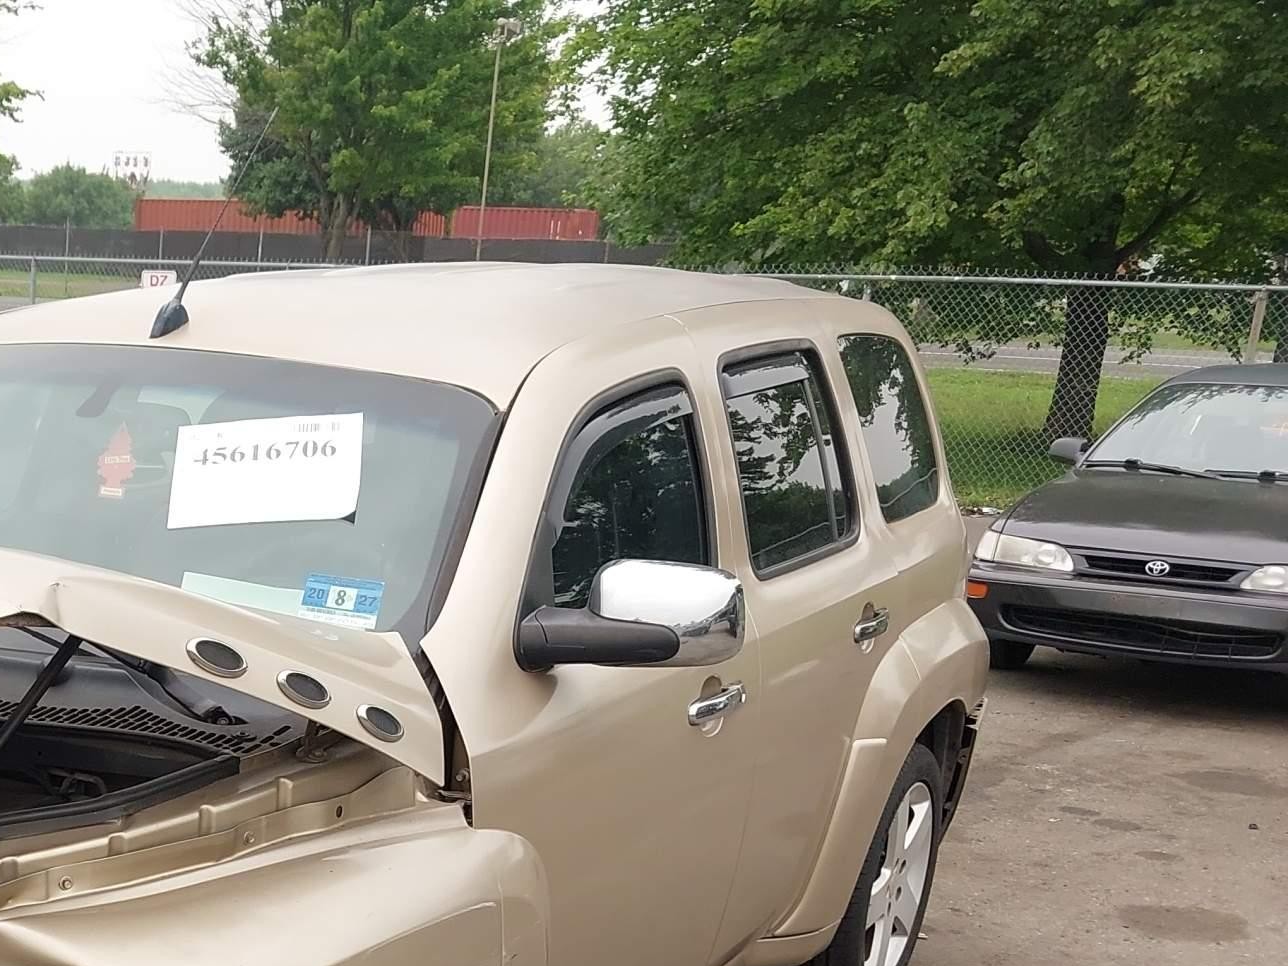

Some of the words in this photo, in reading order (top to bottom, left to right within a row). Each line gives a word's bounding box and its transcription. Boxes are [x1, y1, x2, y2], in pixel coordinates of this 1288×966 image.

[193, 440, 337, 466] 45616706
[307, 587, 326, 600] 20
[334, 589, 347, 606] 8
[358, 594, 378, 607] 27
